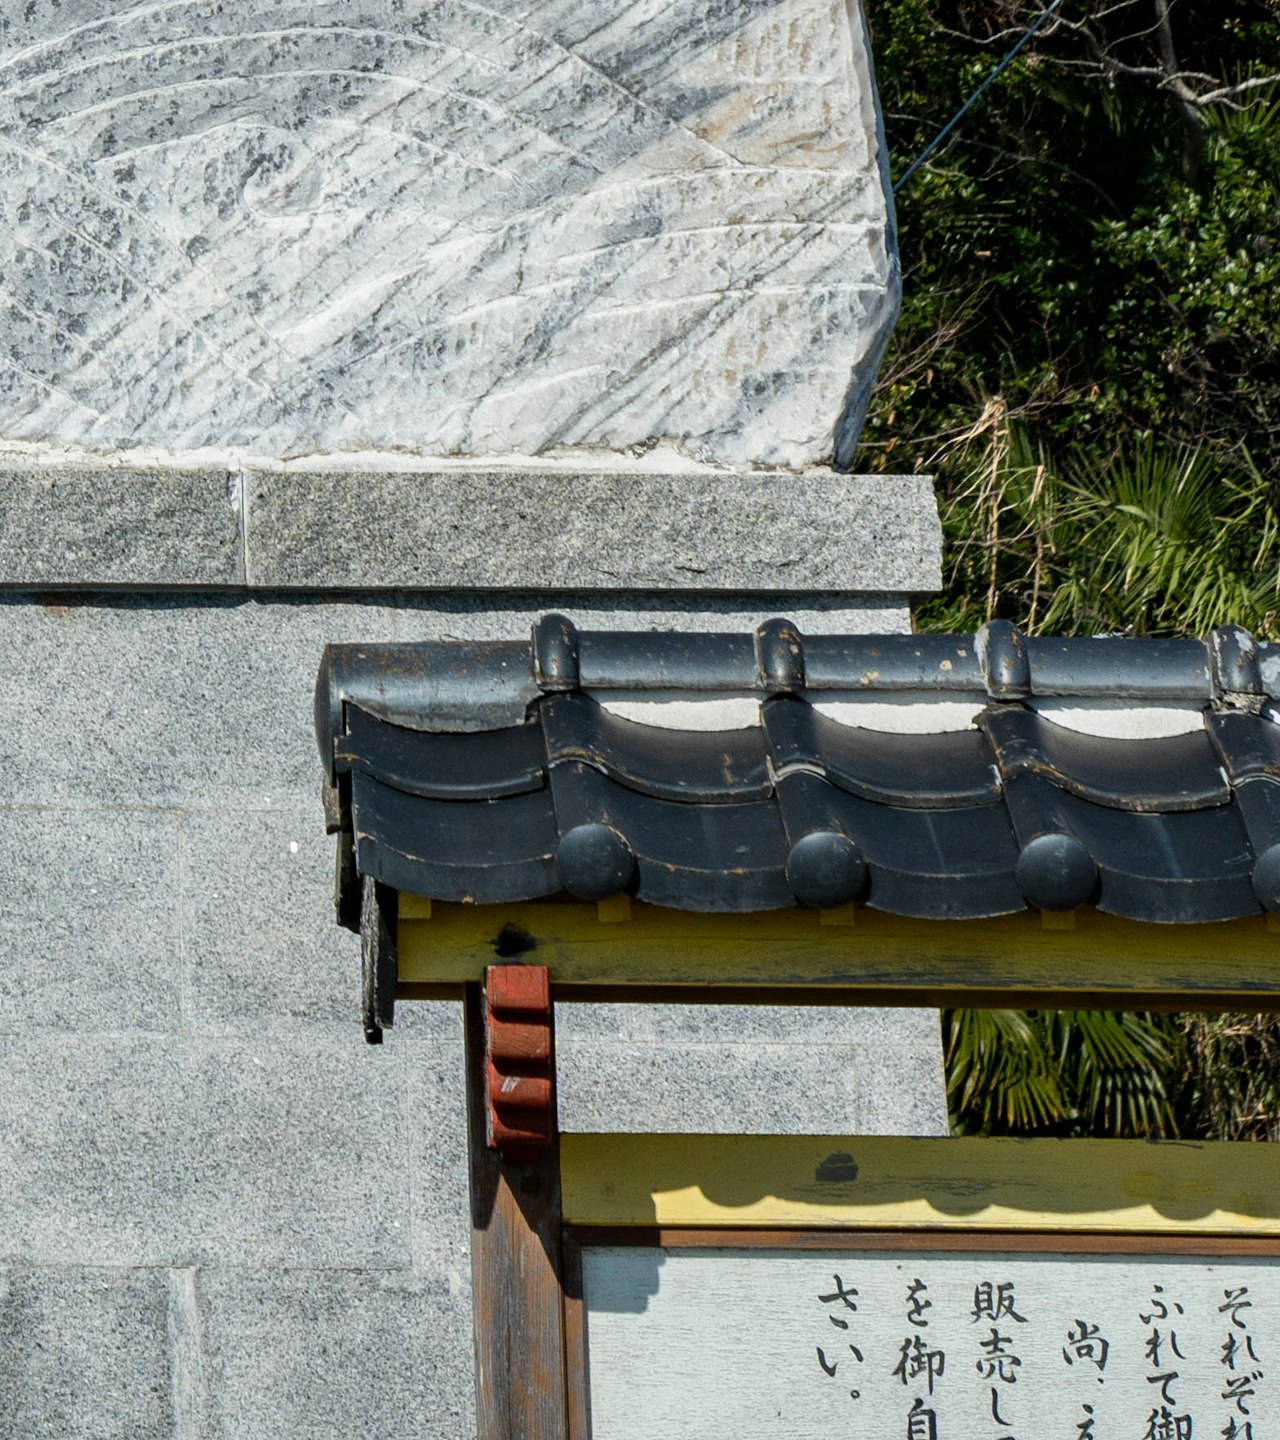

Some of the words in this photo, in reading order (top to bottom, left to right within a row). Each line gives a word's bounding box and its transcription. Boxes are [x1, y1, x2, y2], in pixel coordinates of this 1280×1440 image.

[816, 1274, 864, 1400] さい。
[970, 1281, 1029, 1440] 販売し
